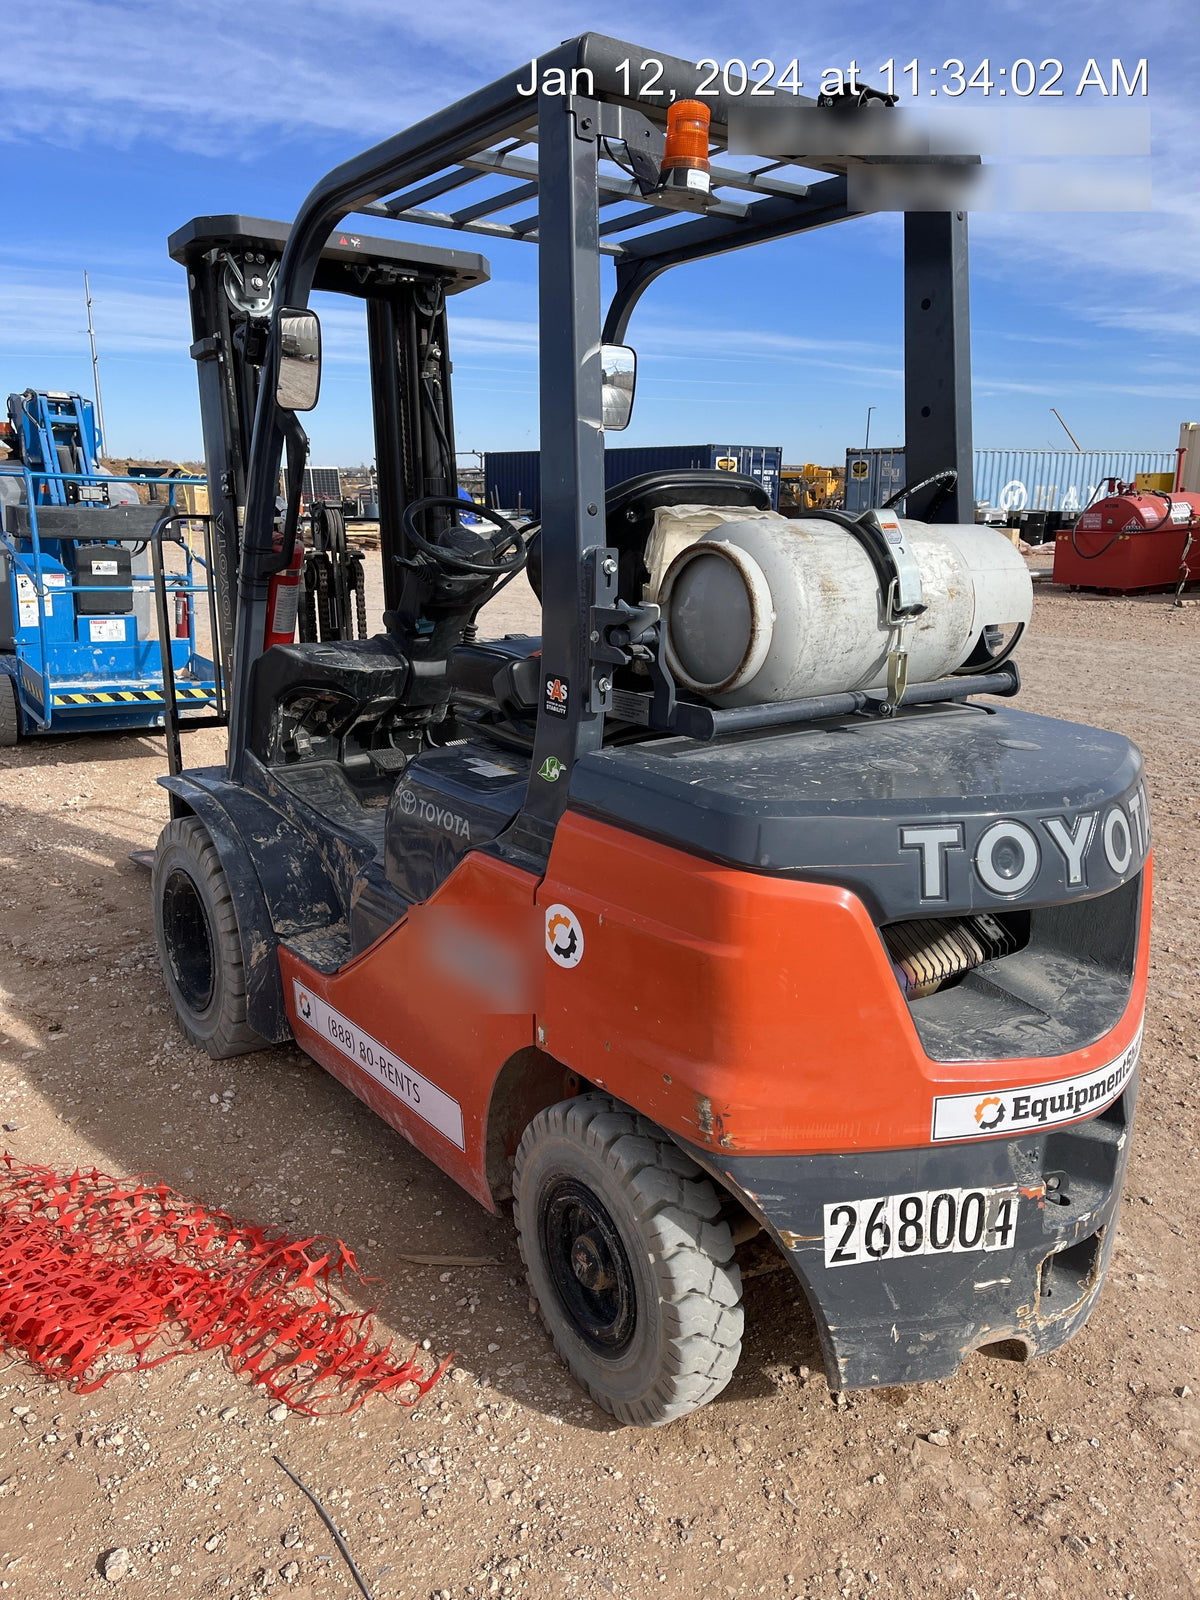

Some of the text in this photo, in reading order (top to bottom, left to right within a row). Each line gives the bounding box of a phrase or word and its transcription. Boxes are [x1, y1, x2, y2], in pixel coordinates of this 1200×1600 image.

[216, 511, 233, 636] TOYOTA
[546, 679, 568, 703] SAS
[418, 799, 471, 840] TOYOTA
[902, 784, 1151, 898] TOYOTA
[327, 1015, 421, 1104] (888) 80-RENTS
[1011, 1036, 1138, 1122] EquipmentS
[829, 1191, 1013, 1263] 268004
